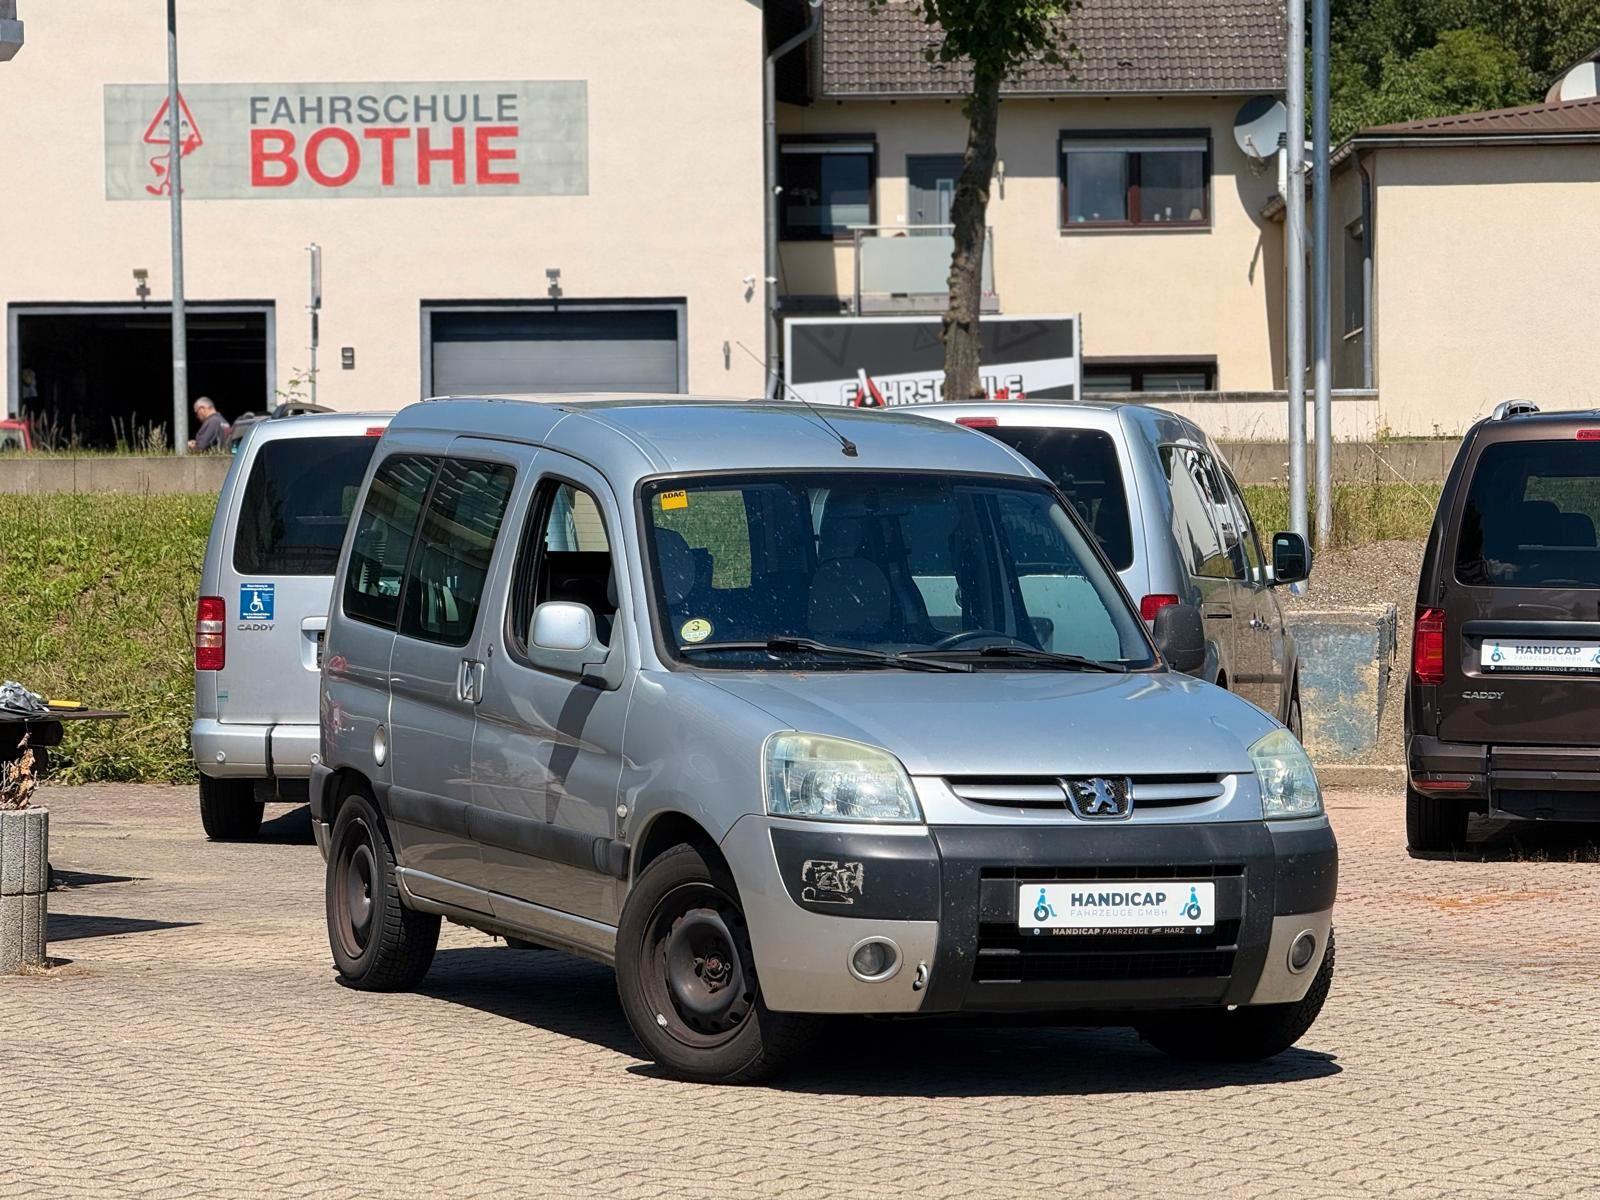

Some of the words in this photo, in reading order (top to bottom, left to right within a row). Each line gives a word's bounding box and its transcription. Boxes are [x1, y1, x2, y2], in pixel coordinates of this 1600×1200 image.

[250, 94, 519, 124] FAHRSCHULE
[251, 126, 521, 187] BOTHE
[839, 371, 1023, 408] FAHRSCLE
[662, 491, 685, 499] ADAC
[692, 620, 700, 631] 3
[1515, 646, 1581, 655] HANDICAP
[1462, 691, 1504, 699] CADDY
[1071, 893, 1167, 907] HANDICAP
[1070, 909, 1134, 917] FAHRZEUGE
[1138, 908, 1168, 917] GMBH
[1102, 927, 1149, 935] FAHRZEUGE
